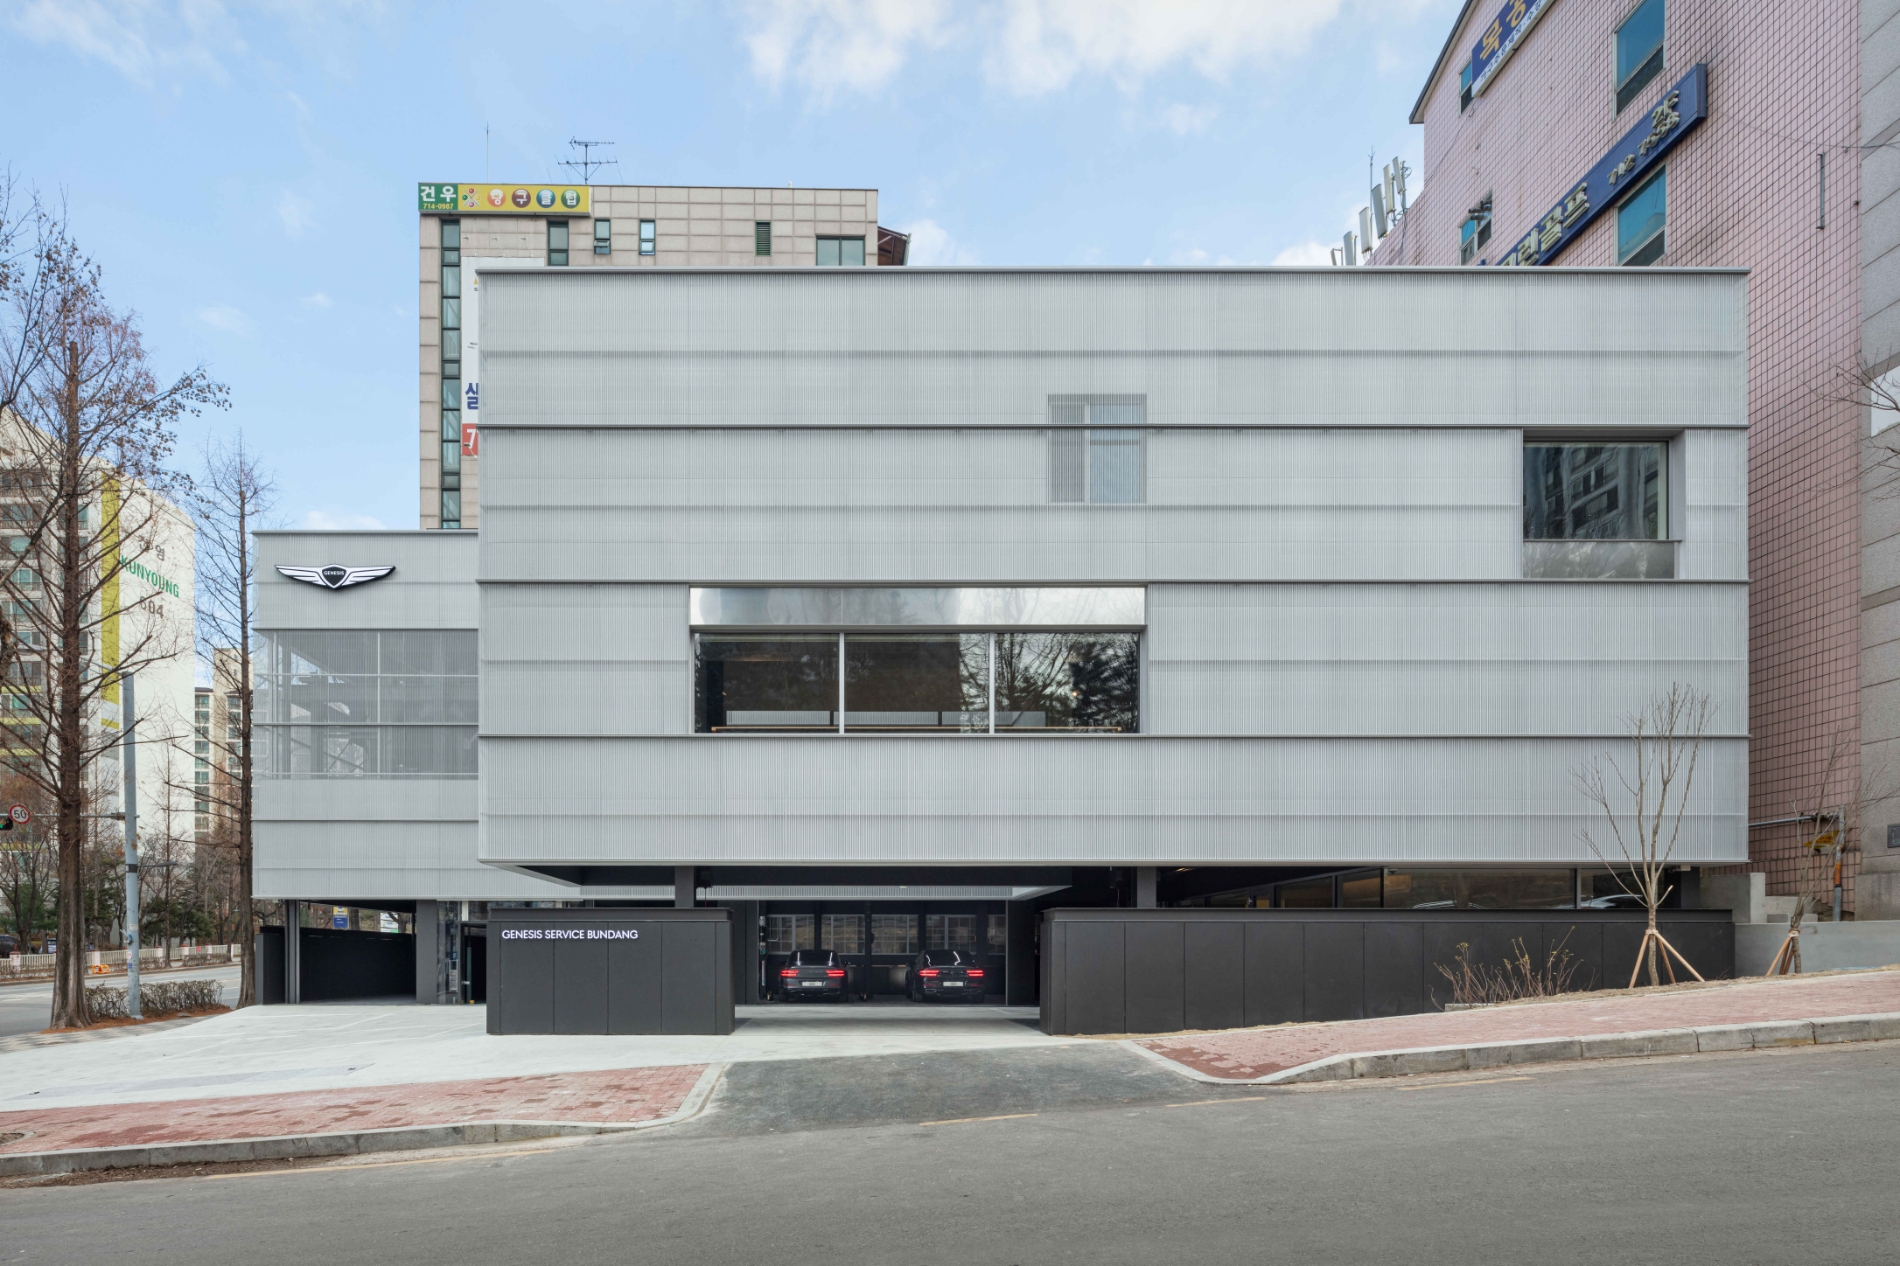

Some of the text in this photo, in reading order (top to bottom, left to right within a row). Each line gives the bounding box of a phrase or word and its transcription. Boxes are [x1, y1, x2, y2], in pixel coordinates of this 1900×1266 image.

[420, 185, 457, 202] 건우
[121, 554, 179, 598] KUNYOUNG
[13, 810, 28, 819] 50
[501, 929, 639, 939] GENESIS SERVICE BUNDANG
